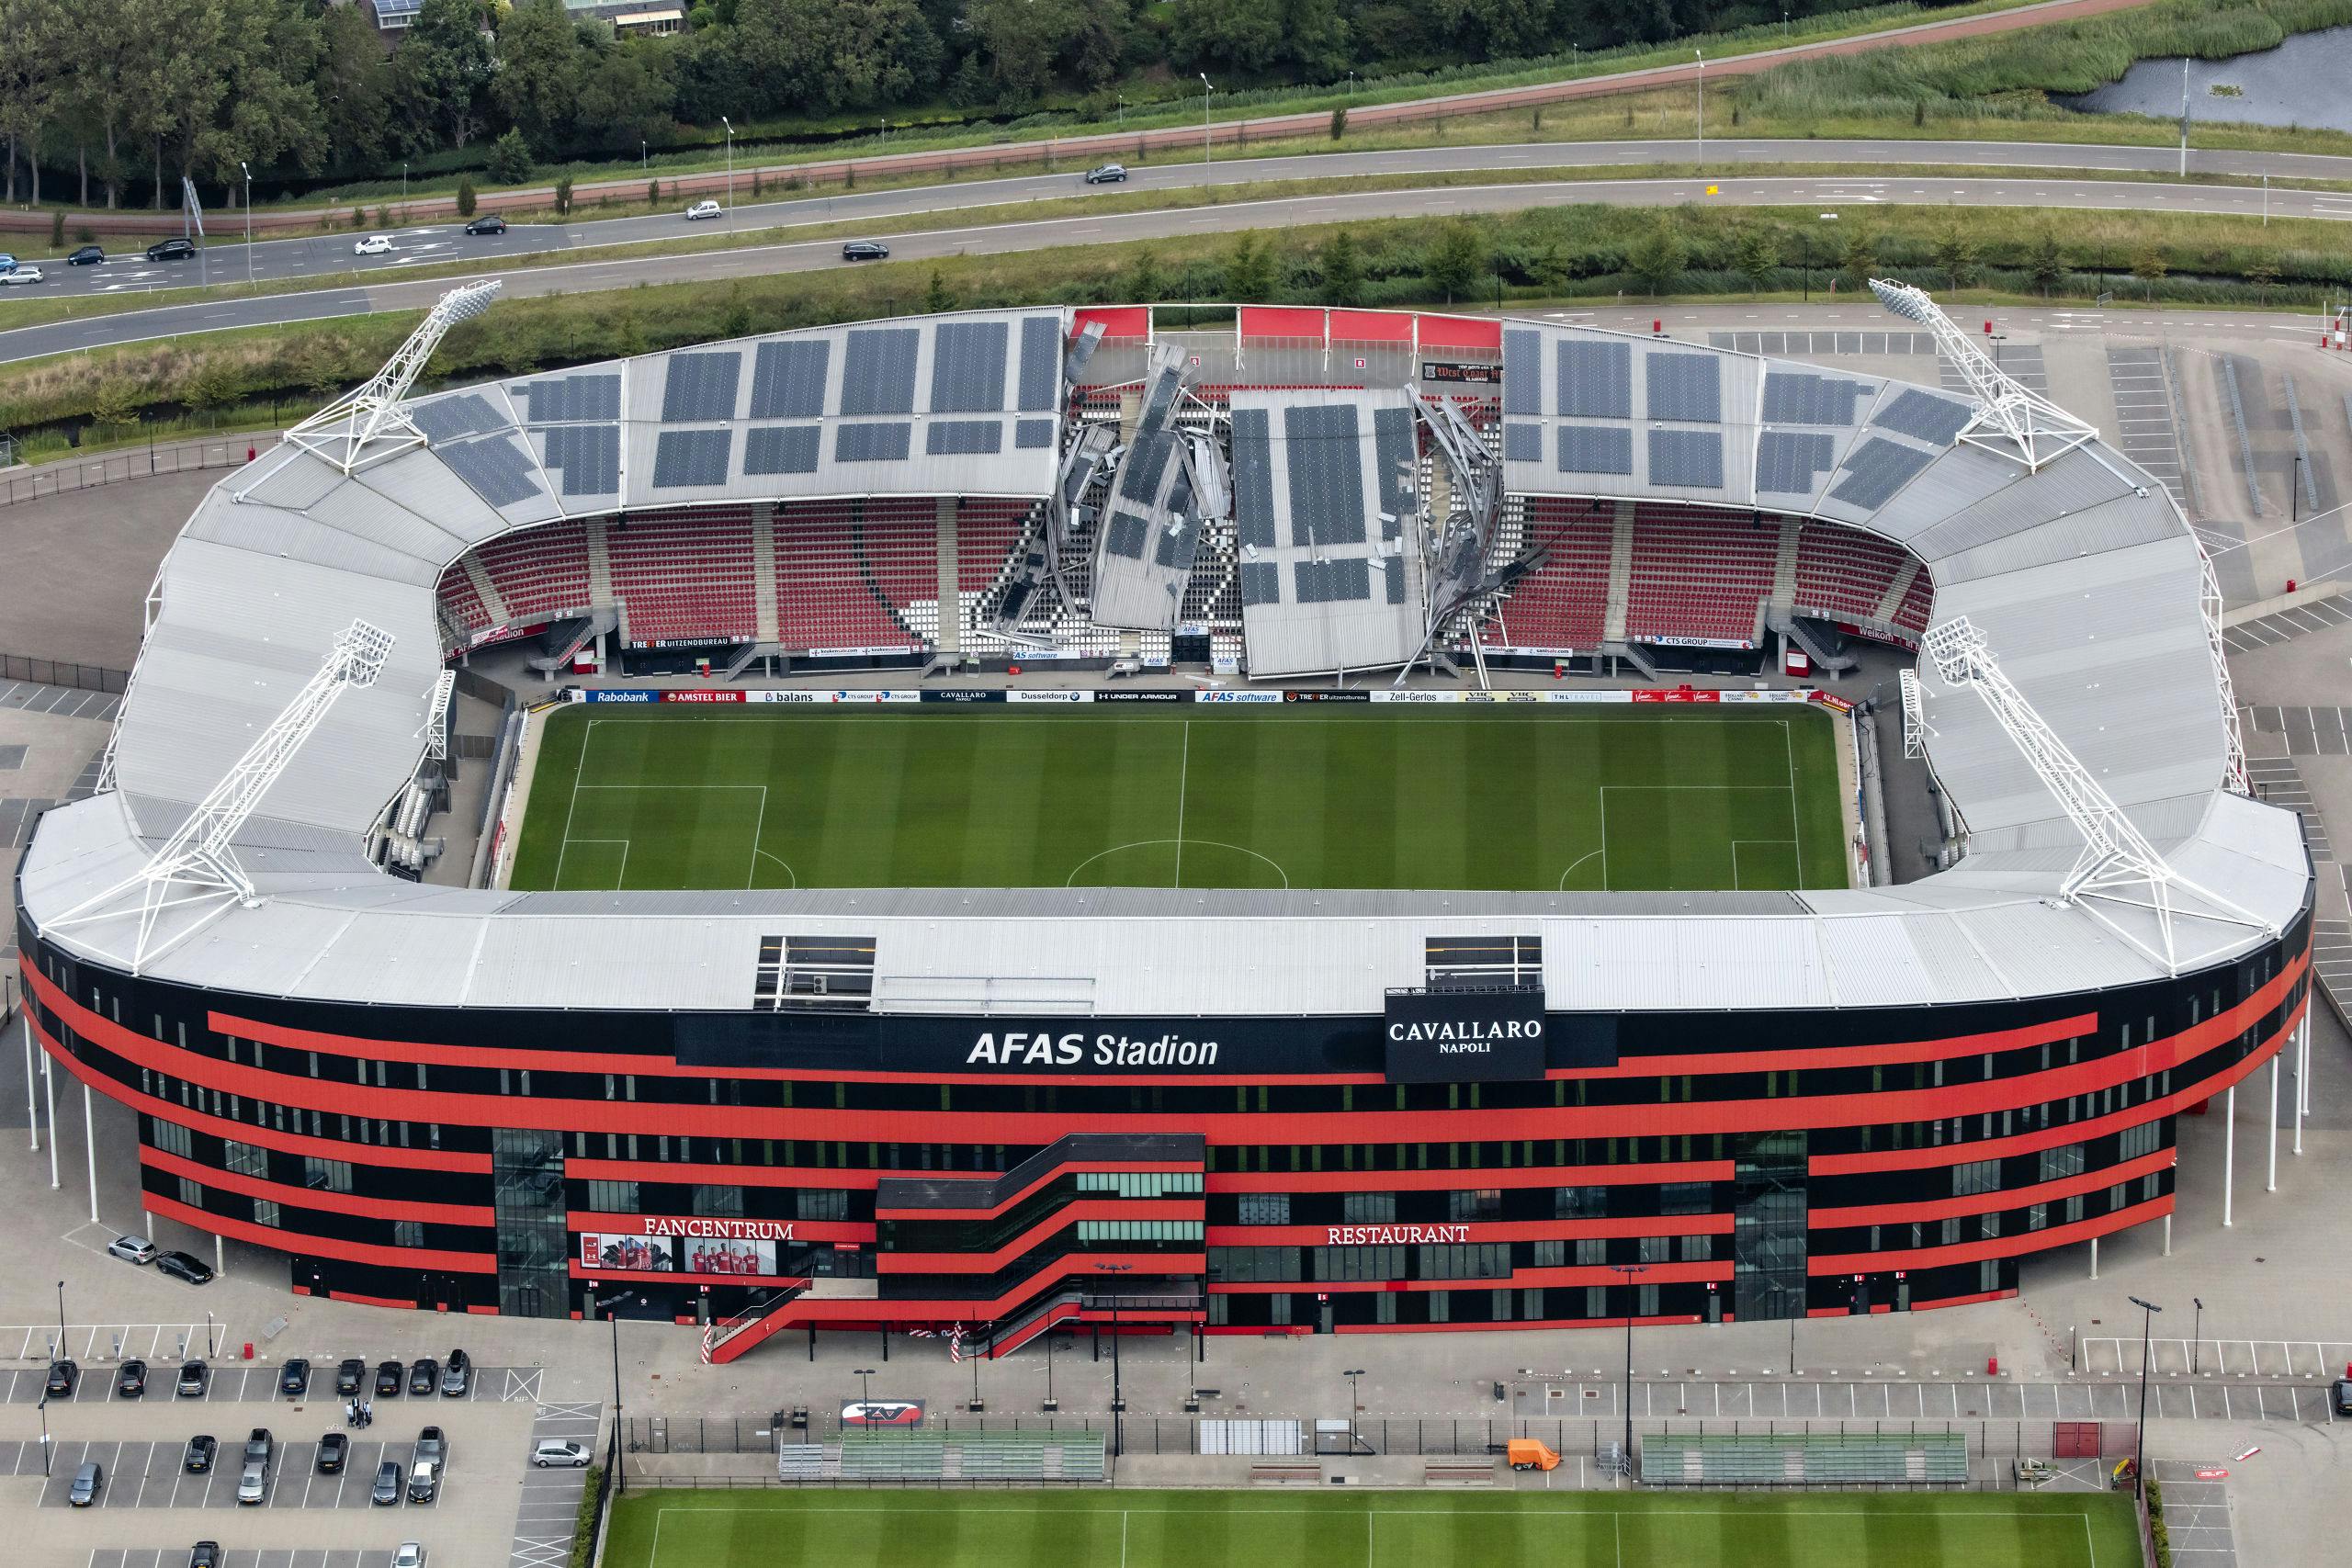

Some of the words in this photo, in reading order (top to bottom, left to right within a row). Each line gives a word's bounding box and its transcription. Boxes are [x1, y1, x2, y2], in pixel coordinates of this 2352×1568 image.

[1437, 367, 1459, 378] West
[1859, 626, 1894, 643] Welkom
[632, 640, 666, 649] TREFFER
[667, 638, 729, 648] UITZENDBUREAU
[598, 693, 649, 702] Rabobank
[678, 694, 714, 702] AMSTEL
[716, 693, 738, 702] BIER
[776, 692, 813, 701] balans
[1021, 693, 1068, 701] Dusseldorp
[1203, 693, 1235, 702] AFAS
[1236, 692, 1277, 702] software
[1389, 693, 1437, 702] Zell-Gerlos
[1389, 1020, 1542, 1041] CAVALLARO
[966, 1033, 1084, 1065] AFAS
[1093, 1034, 1218, 1066] Stadion
[1439, 1043, 1490, 1054] NAPOLI
[644, 1218, 794, 1240] FANCENTRUM
[1328, 1225, 1469, 1245] RESTAURANT
